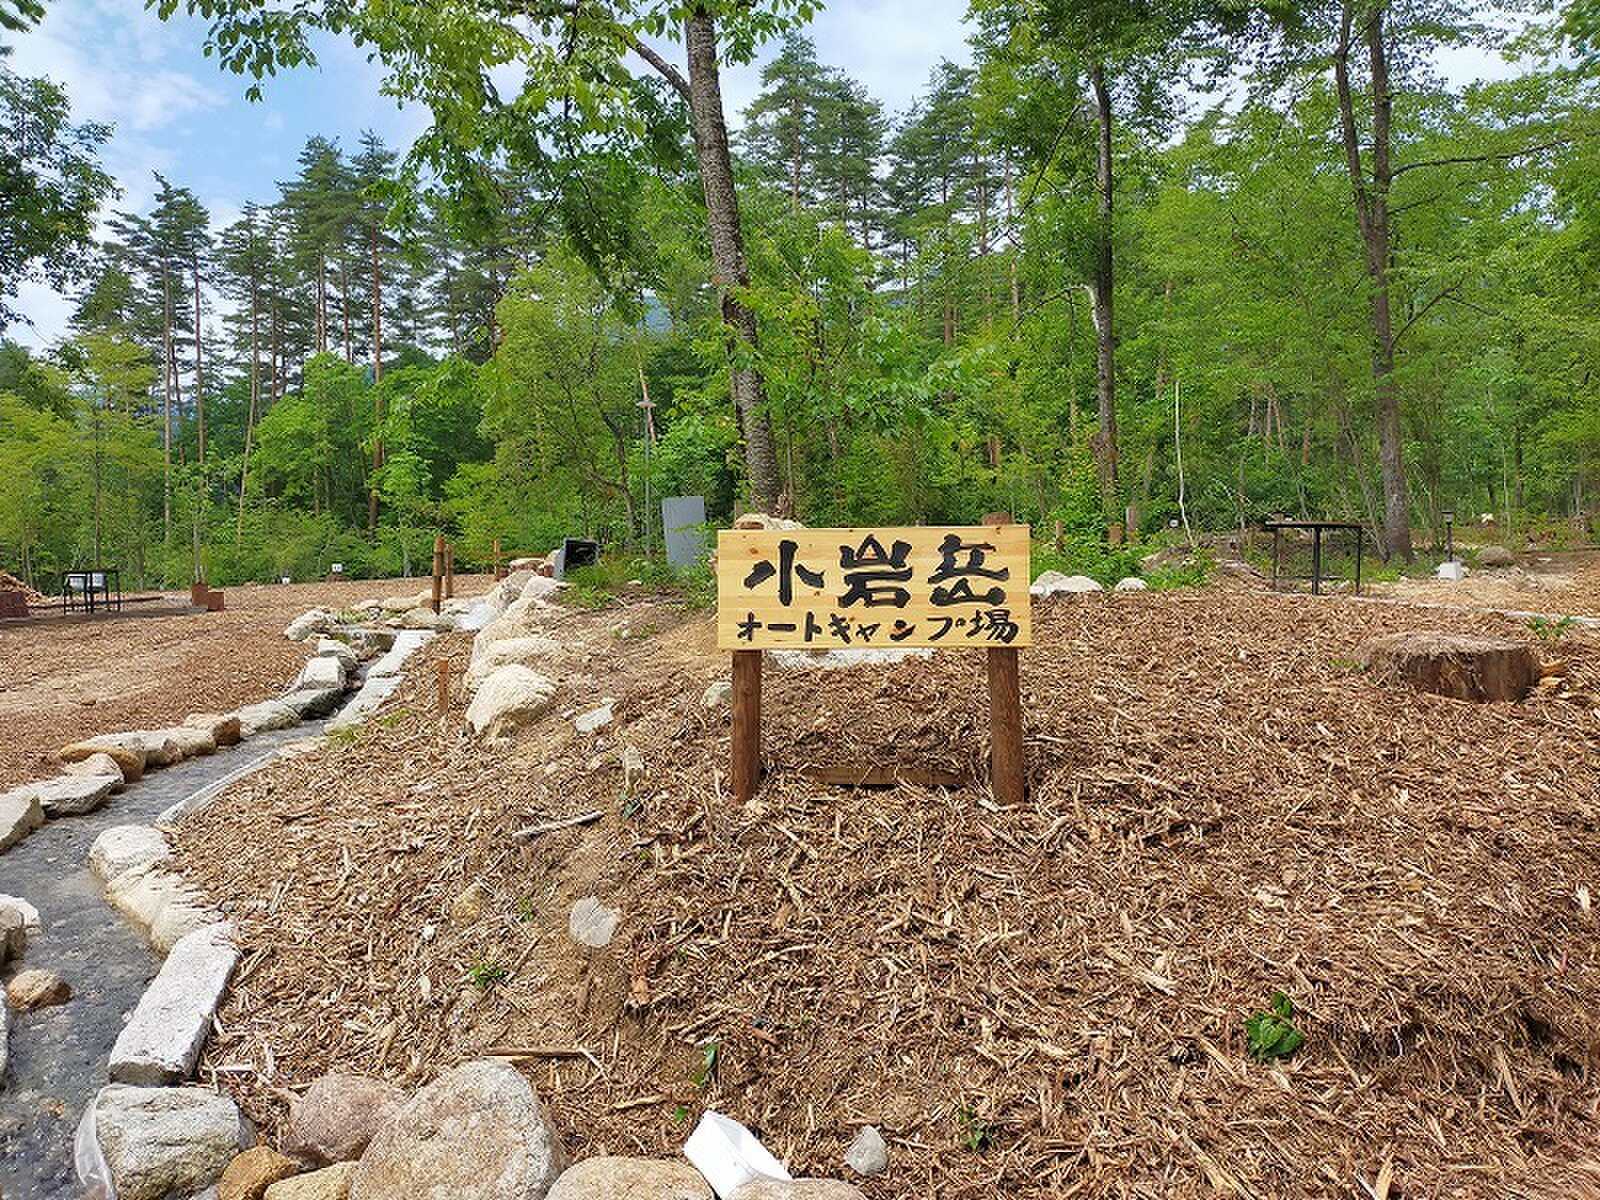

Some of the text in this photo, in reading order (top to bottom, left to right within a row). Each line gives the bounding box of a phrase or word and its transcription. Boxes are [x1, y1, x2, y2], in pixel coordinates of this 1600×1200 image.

[743, 533, 1010, 609] 小岩岳
[737, 609, 1020, 644] オートキャンプ場
